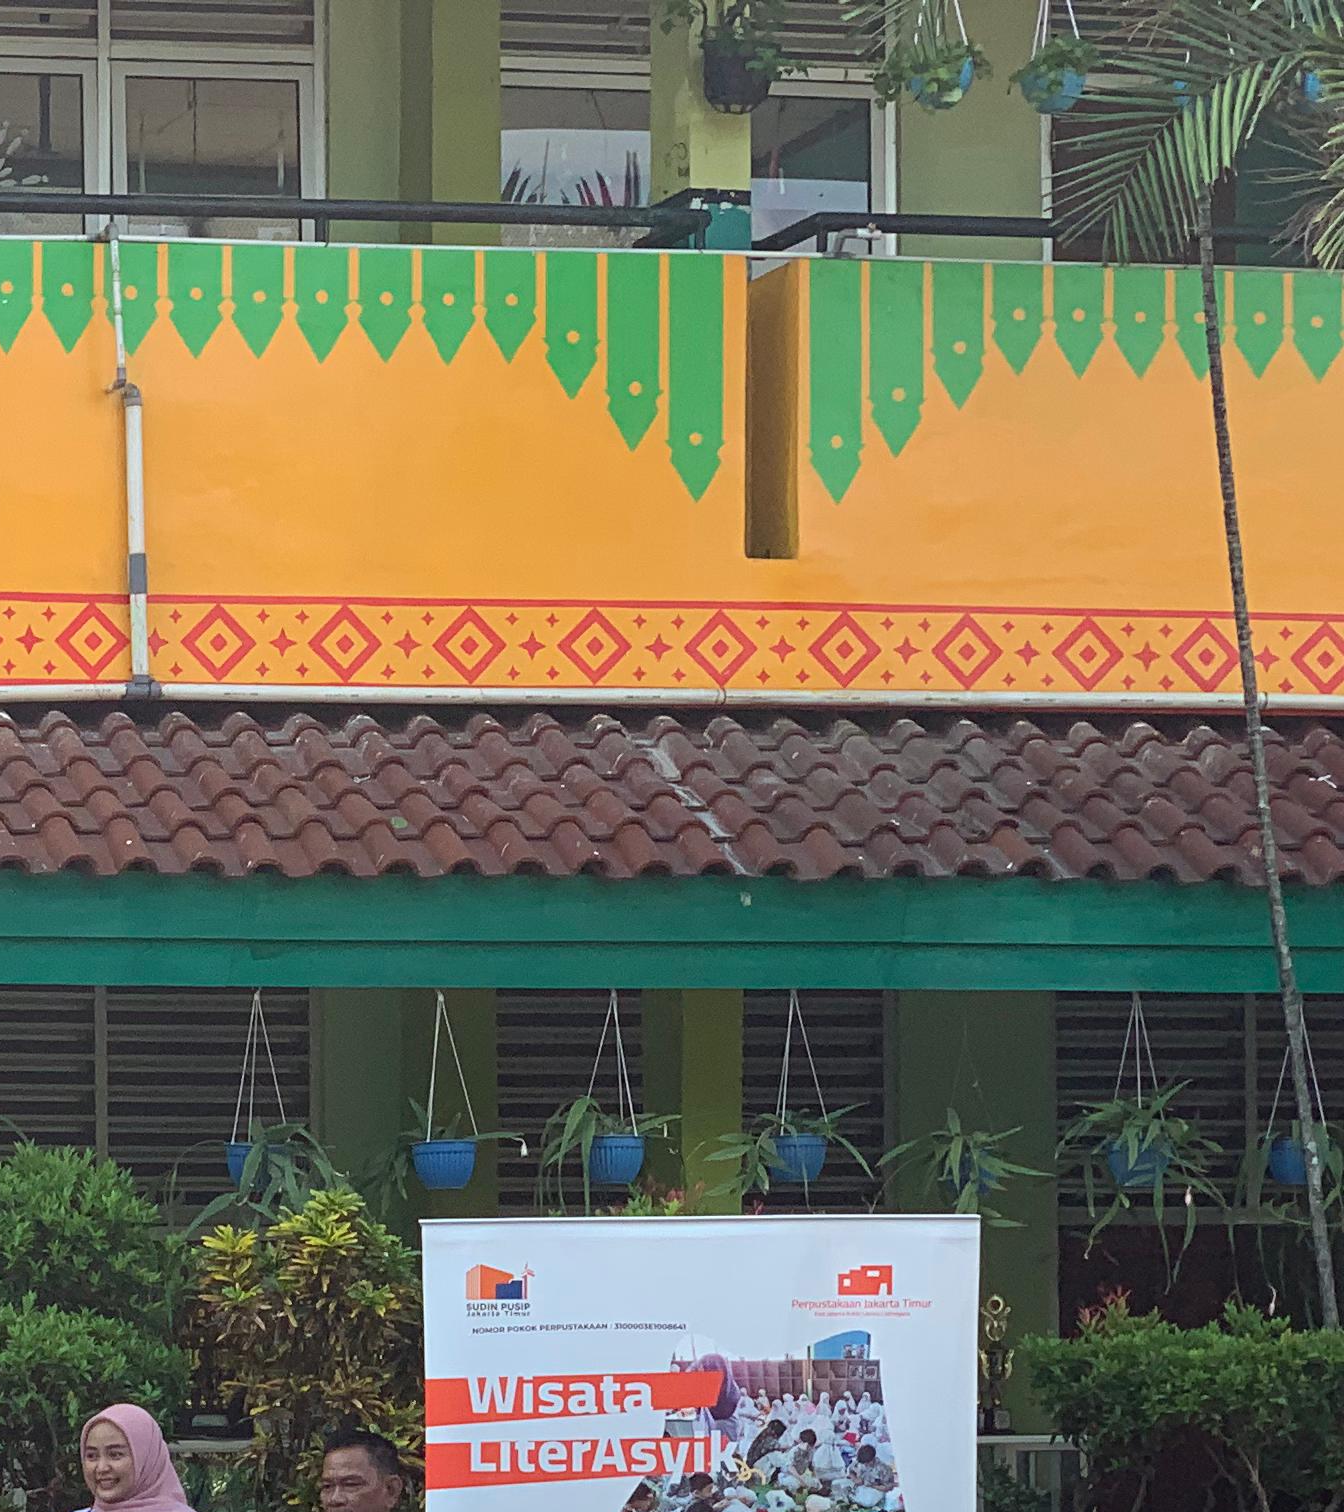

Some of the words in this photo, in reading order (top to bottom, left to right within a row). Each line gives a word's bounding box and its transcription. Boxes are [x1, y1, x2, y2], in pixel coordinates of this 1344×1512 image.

[466, 1303, 498, 1311] SUDIN
[501, 1303, 530, 1311] PUSIP
[904, 1298, 932, 1308] Timur
[472, 1327, 505, 1335] NOMOR
[507, 1325, 537, 1333] POKOK
[539, 1323, 608, 1331] PERPUSTAKAAN
[467, 1375, 654, 1415] Wisata
[470, 1429, 740, 1484] LiterAsyik
